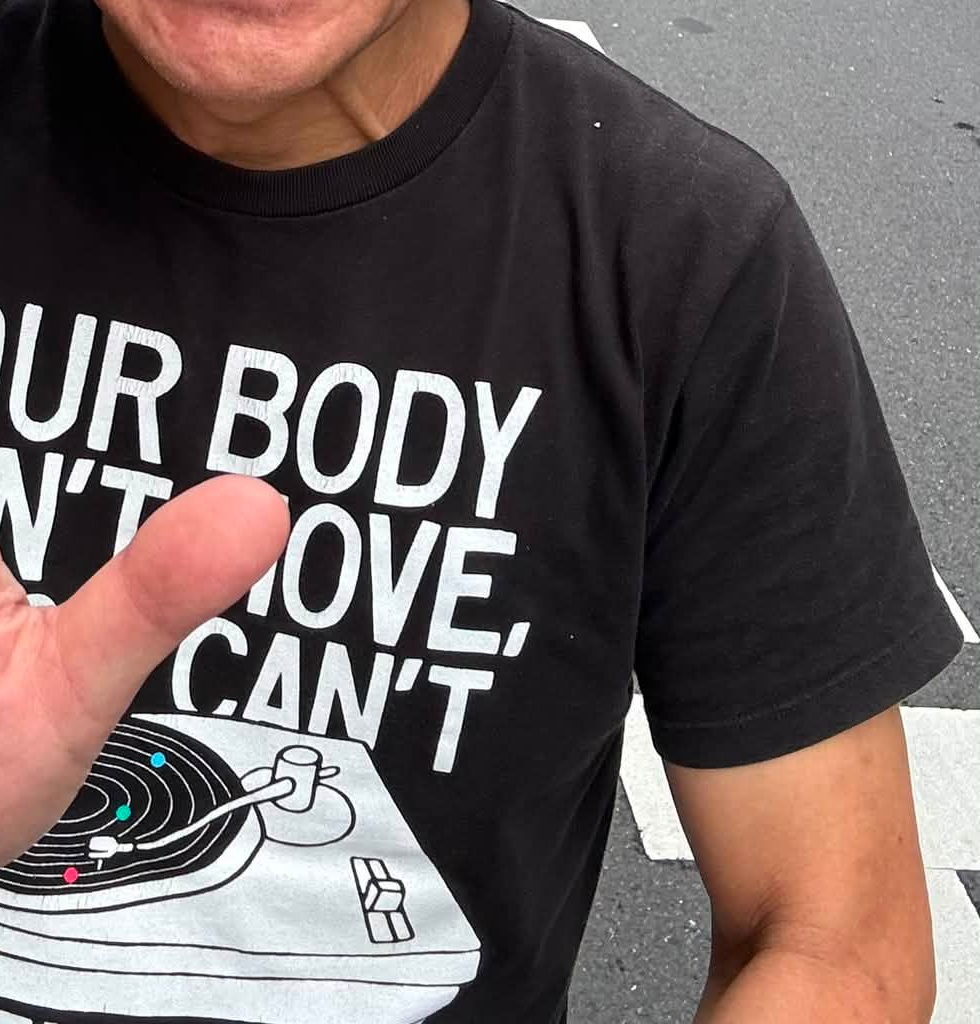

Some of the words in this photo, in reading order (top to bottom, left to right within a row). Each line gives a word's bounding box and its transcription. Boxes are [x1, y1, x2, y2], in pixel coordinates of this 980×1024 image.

[206, 343, 543, 520] BODY
[246, 494, 531, 657] OVE,
[172, 617, 495, 774] CAN'T
